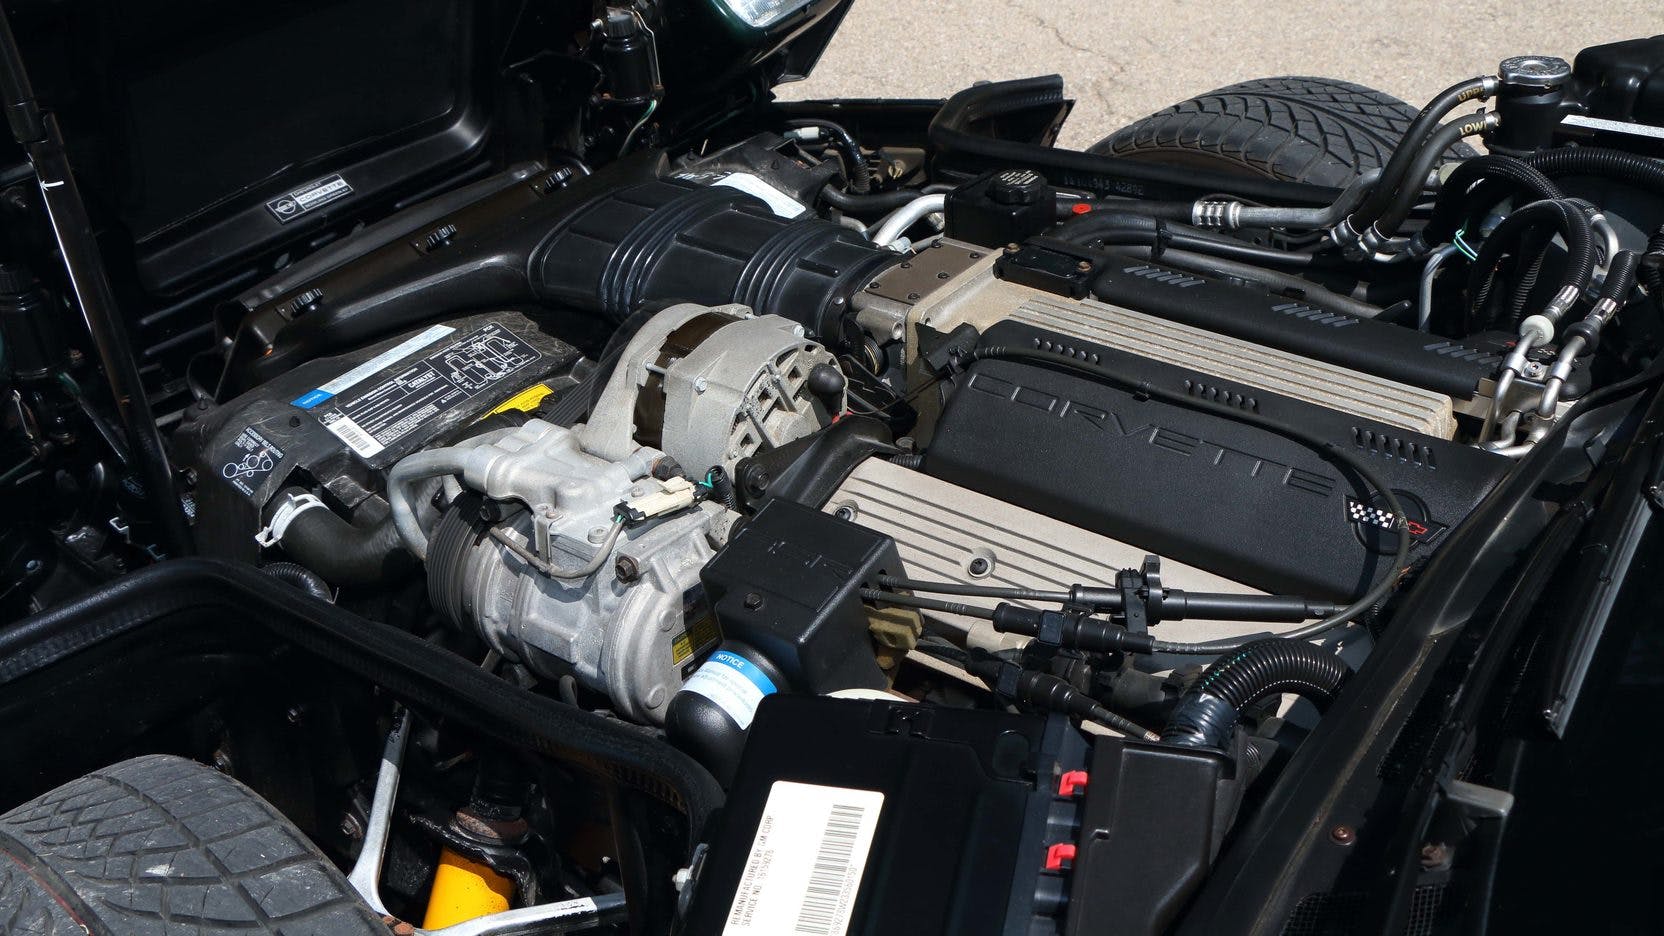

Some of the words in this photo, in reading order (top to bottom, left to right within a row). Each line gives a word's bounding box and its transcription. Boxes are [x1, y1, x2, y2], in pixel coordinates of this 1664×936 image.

[300, 181, 343, 202] CORVETTE
[407, 371, 435, 388] CATALYST
[969, 373, 1337, 498] CORVETTE
[716, 653, 745, 669] NOTICE
[730, 857, 759, 925] REMANUFACTURED
[753, 847, 762, 857] BY
[741, 896, 758, 927] SERVICE
